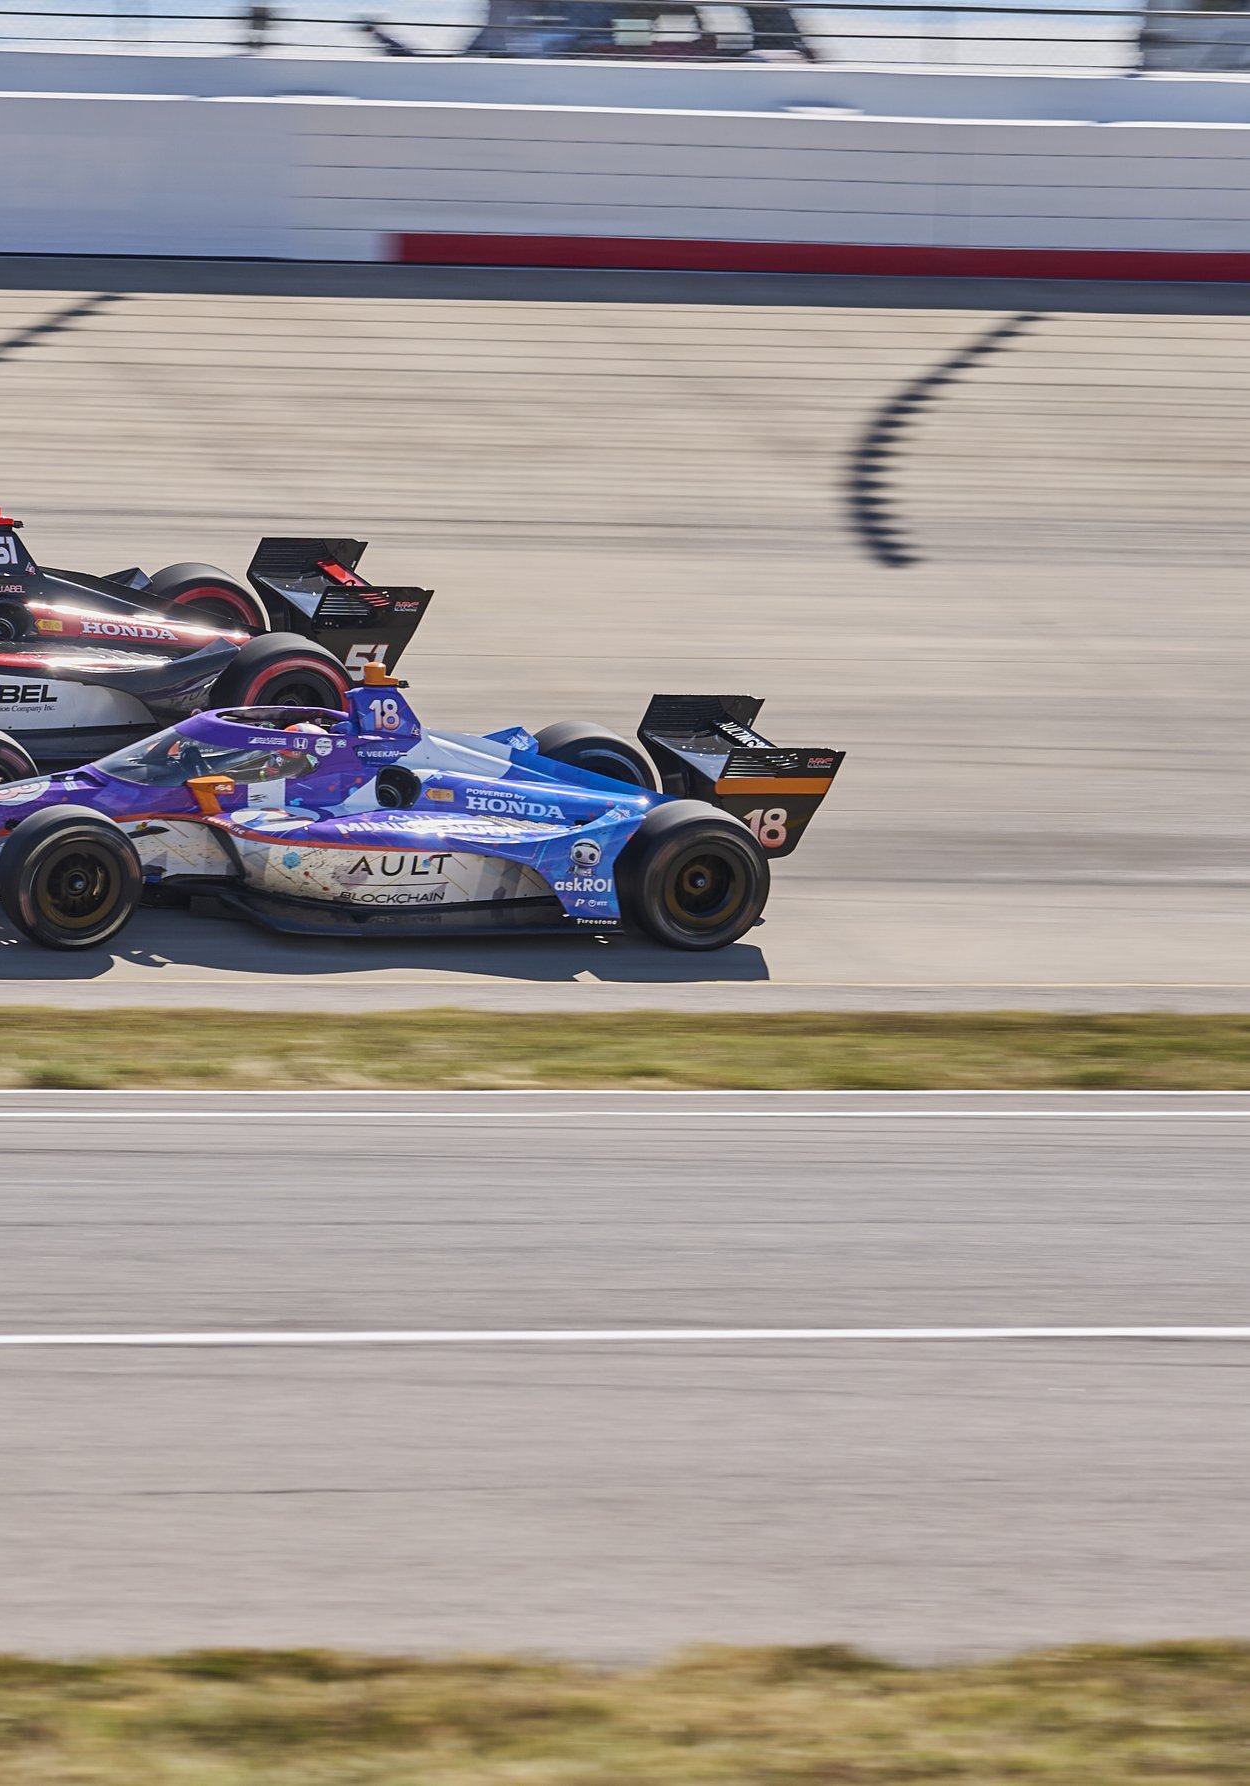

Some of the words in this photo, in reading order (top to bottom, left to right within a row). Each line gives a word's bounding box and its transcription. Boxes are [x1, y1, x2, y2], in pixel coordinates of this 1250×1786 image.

[80, 621, 179, 641] HONDA
[344, 643, 390, 682] 51
[11, 704, 42, 714] Company
[43, 704, 56, 712] Inc.
[368, 698, 401, 731] 18
[465, 787, 513, 799] POWERED
[514, 793, 526, 801] by
[465, 796, 566, 820] HONDA
[743, 807, 788, 849] 18
[347, 853, 452, 877] AULT
[554, 877, 613, 893] askROI
[339, 890, 446, 905] BLOCKCHAIN
[575, 917, 618, 925] Firestone
